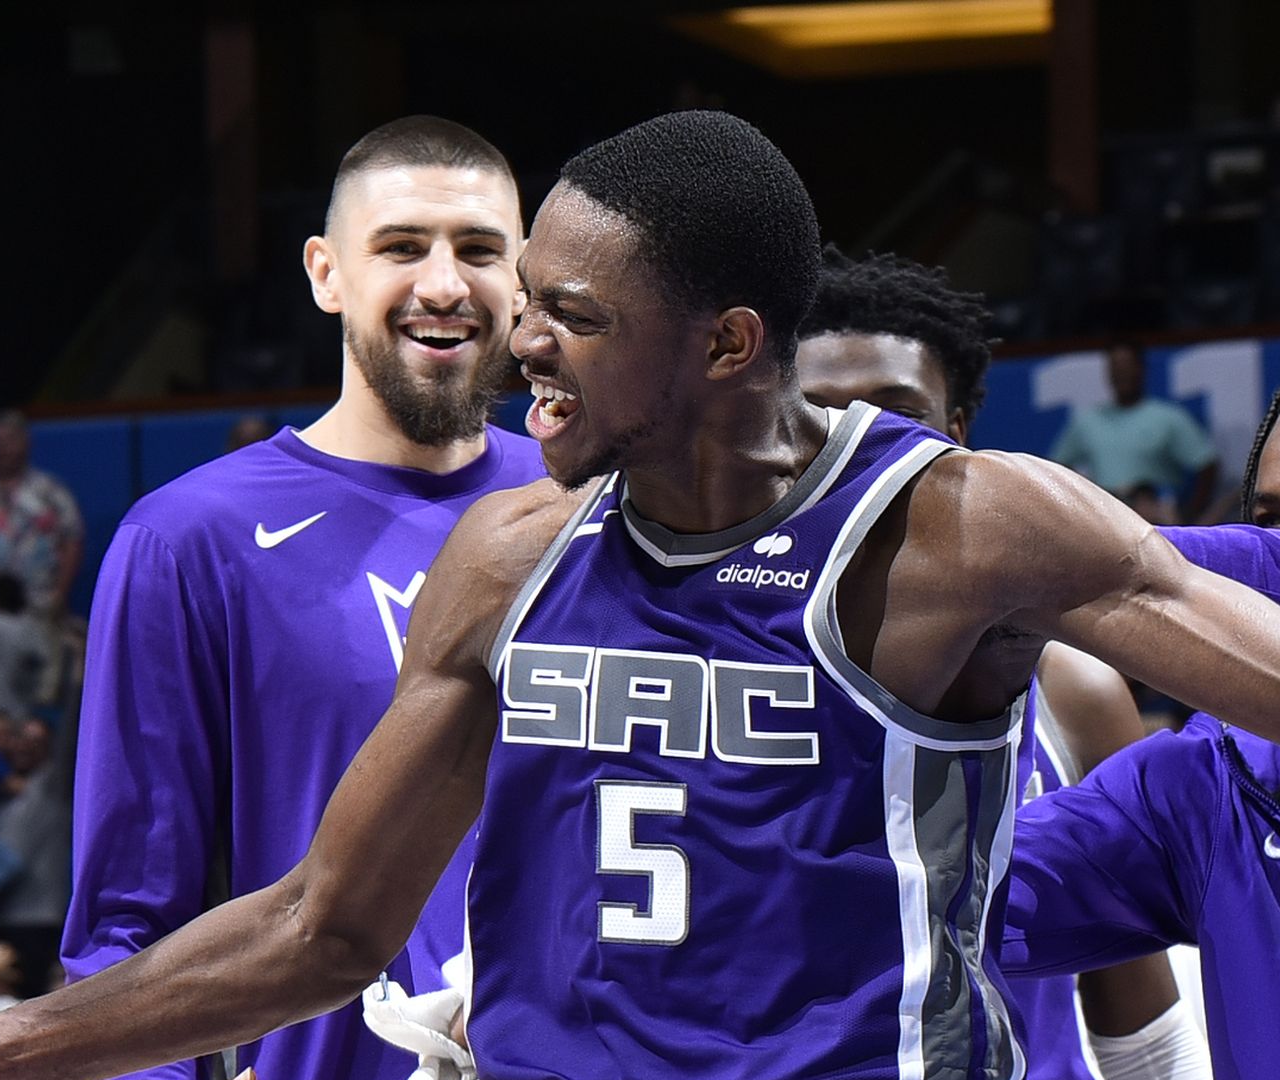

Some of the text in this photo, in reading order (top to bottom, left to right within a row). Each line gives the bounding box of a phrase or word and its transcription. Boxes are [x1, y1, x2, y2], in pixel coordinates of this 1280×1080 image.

[716, 564, 810, 590] dialpad
[502, 641, 820, 765] SAC
[593, 779, 691, 946] 5
